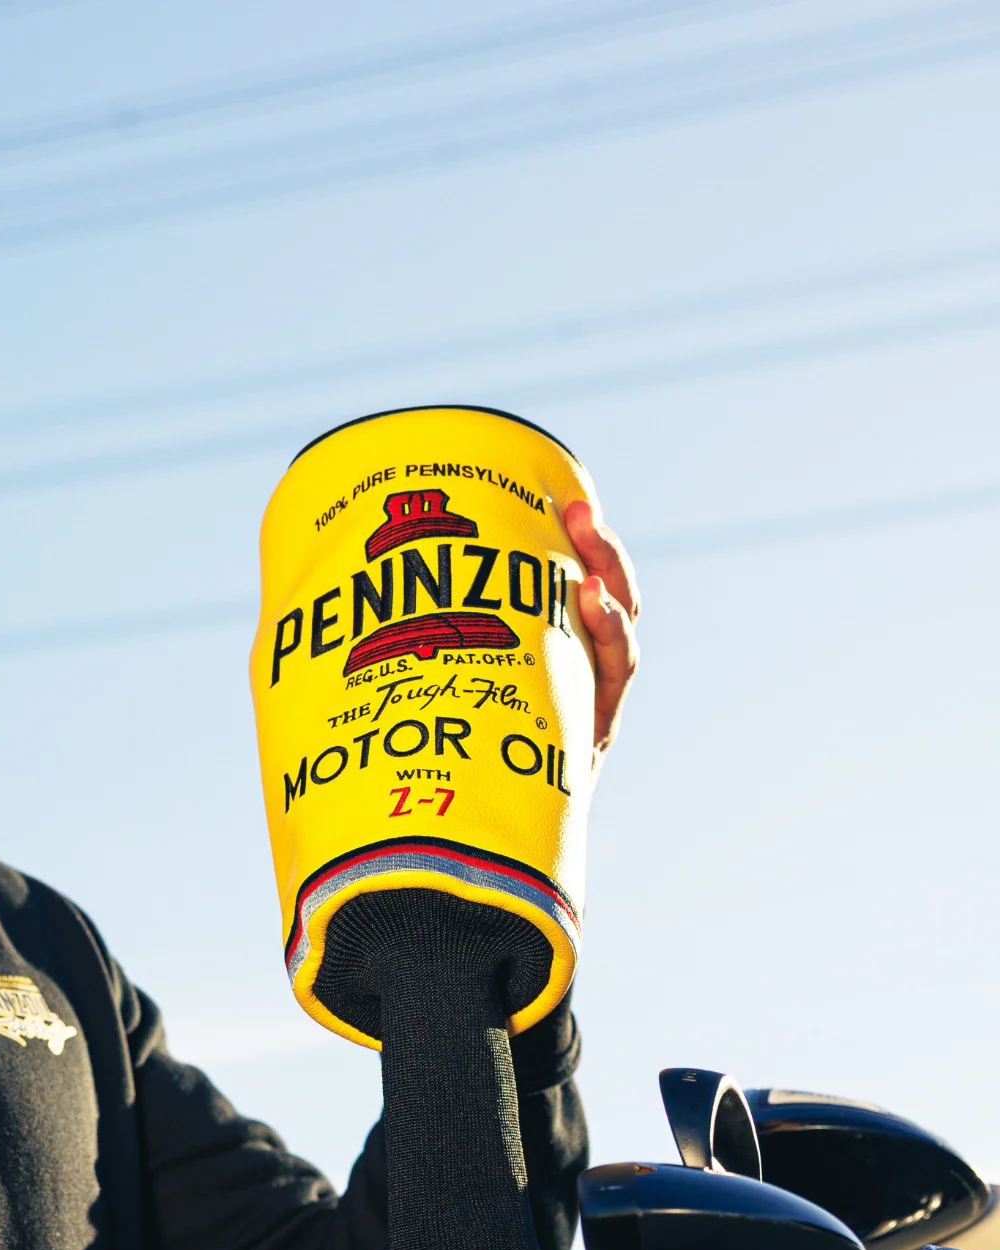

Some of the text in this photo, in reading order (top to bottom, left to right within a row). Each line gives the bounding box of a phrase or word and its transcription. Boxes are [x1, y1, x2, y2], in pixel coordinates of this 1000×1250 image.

[314, 463, 546, 532] 100% PURE PENNSYLVANIA
[270, 543, 571, 689] PENNZOIL
[327, 702, 371, 729] THE
[371, 674, 531, 723] Tough-Film
[283, 716, 571, 814] MOTOR OIL
[396, 768, 451, 782] WITH
[388, 786, 455, 818] Z-7
